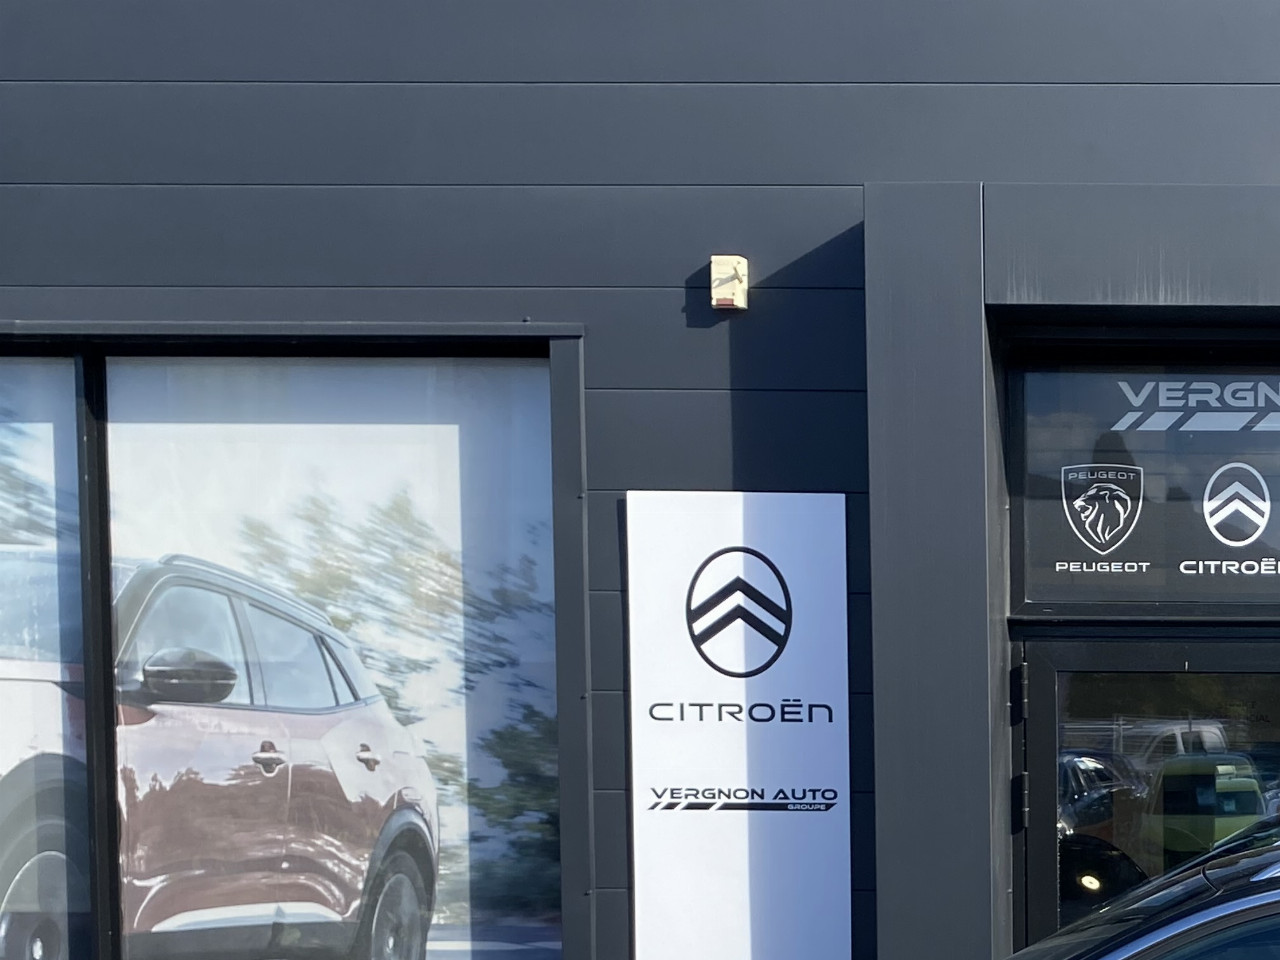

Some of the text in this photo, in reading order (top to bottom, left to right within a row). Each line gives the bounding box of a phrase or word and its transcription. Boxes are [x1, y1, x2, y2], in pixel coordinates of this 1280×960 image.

[1067, 470, 1136, 482] PEUGEOT
[1055, 562, 1151, 573] PEUGEOT
[649, 699, 834, 723] CITROËN
[650, 787, 838, 801] VERGNON AUTO
